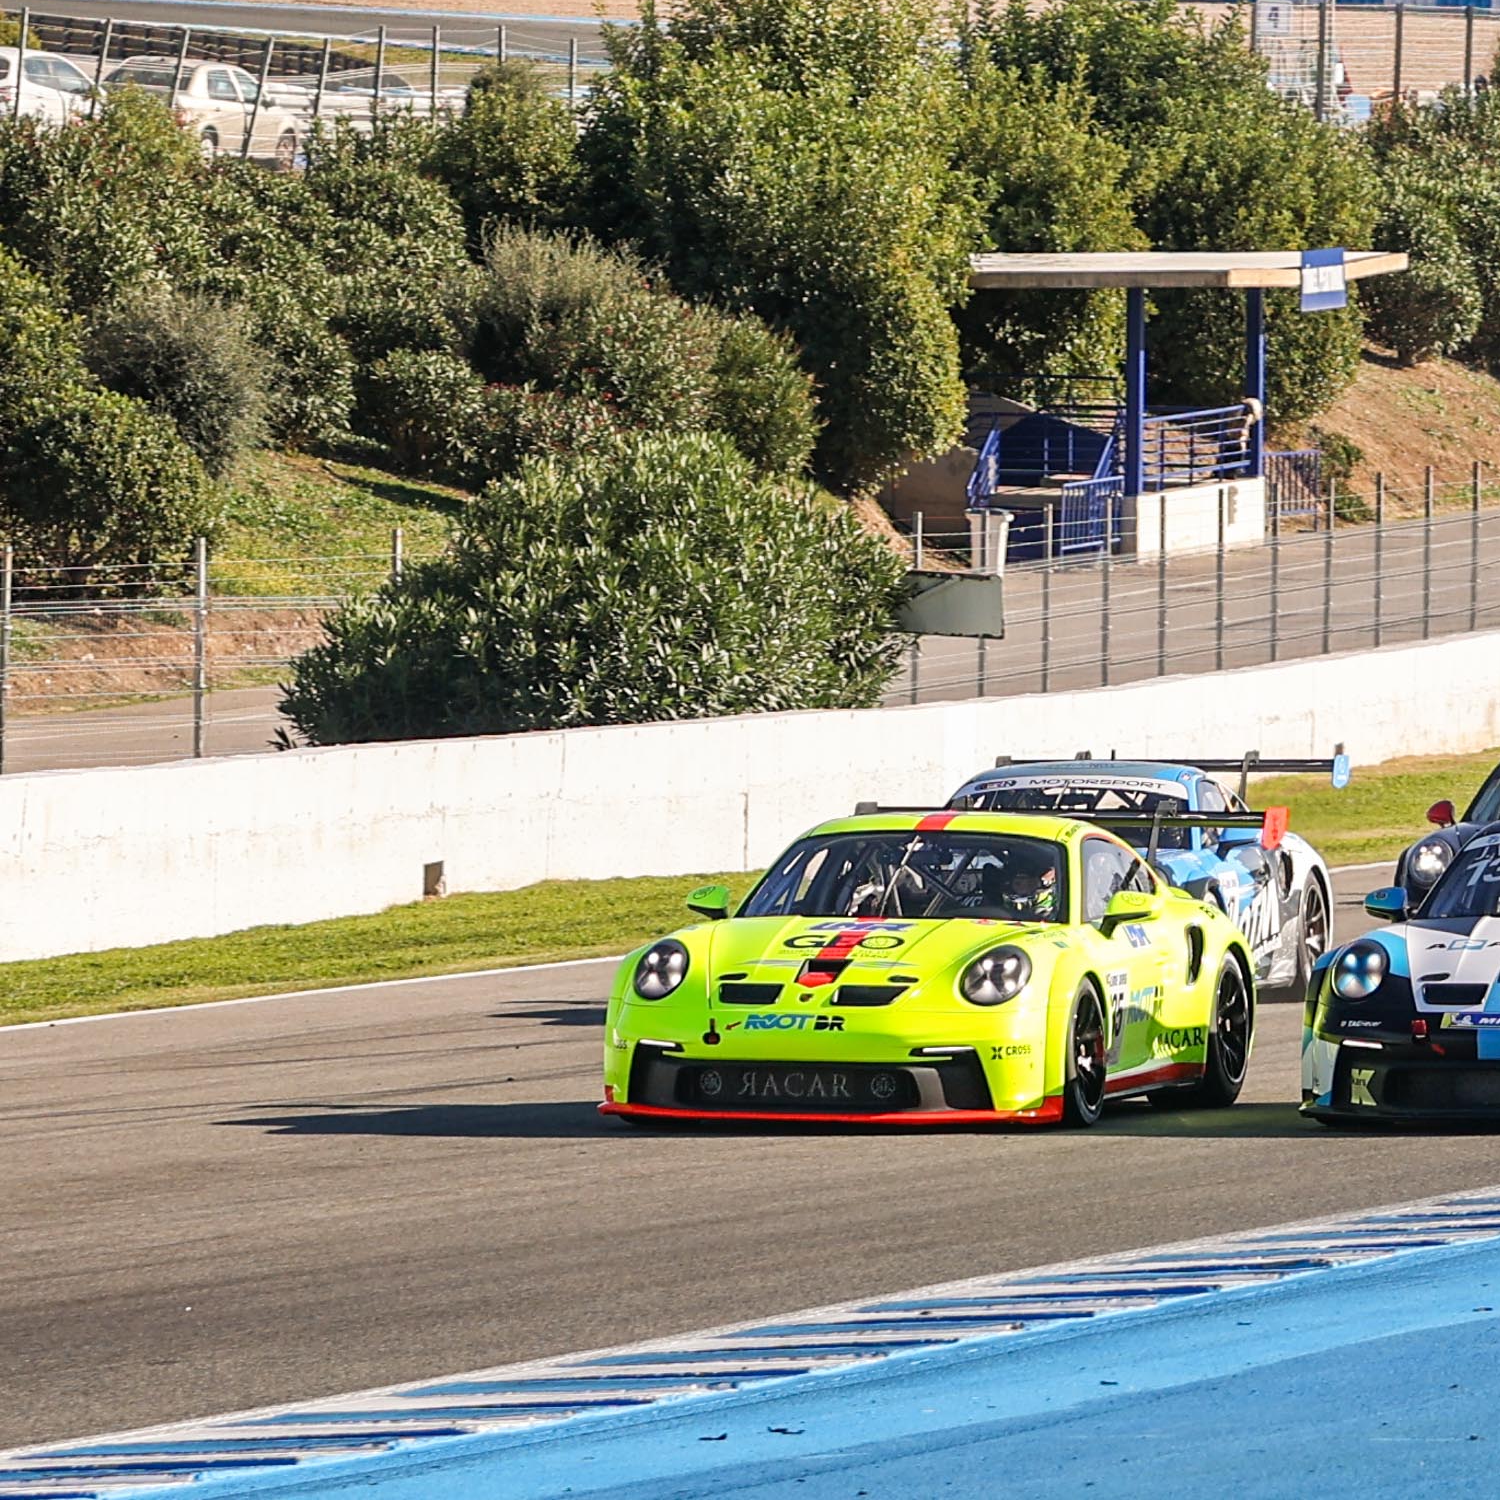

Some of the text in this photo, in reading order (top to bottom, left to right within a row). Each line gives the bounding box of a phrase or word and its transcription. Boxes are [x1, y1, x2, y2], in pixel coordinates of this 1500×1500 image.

[1028, 778, 1168, 790] MOTORSPORT
[784, 935, 905, 950] GEO
[1005, 1045, 1031, 1056] CROSS
